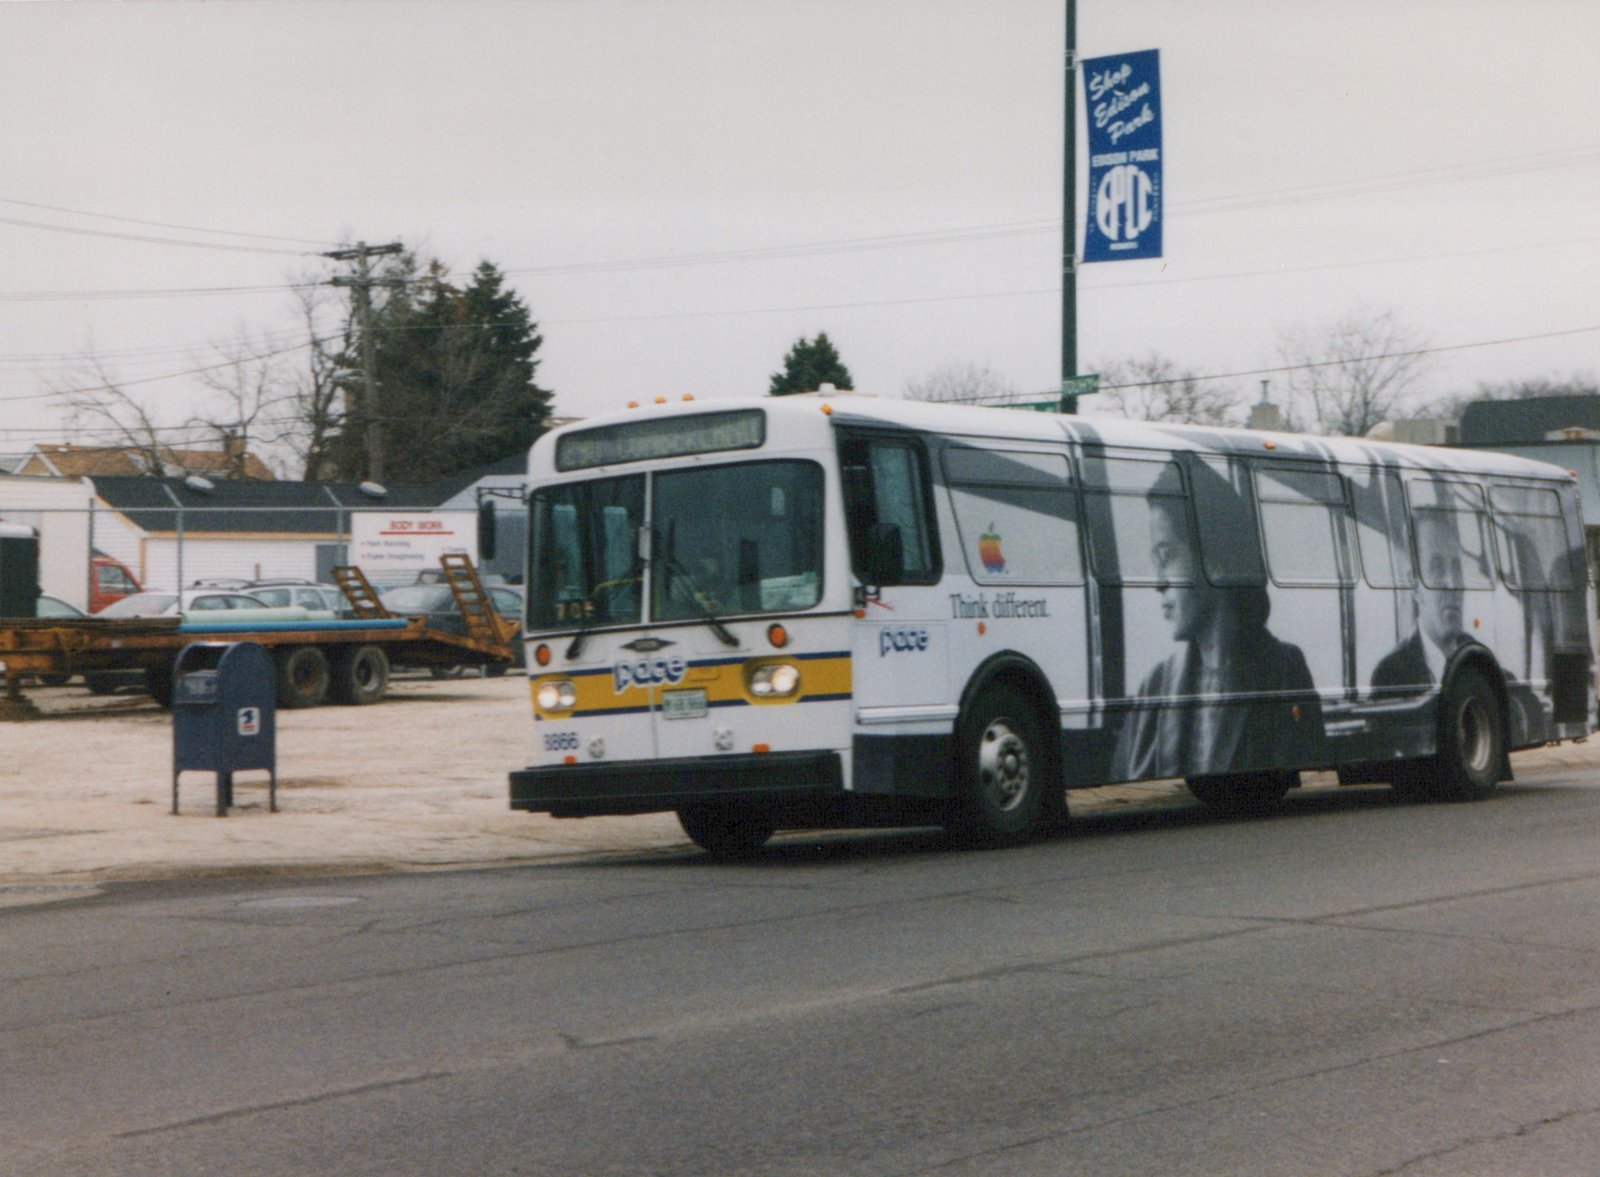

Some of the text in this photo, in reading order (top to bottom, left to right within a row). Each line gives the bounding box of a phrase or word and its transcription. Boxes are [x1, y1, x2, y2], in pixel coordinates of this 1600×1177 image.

[1089, 63, 1132, 100] Shop
[1094, 82, 1149, 127] Edison
[1107, 103, 1154, 145] Park
[1129, 148, 1158, 162] PARK
[390, 521, 442, 530] BODY WORK
[950, 591, 1051, 619] Think different.
[880, 627, 929, 657] pace
[615, 657, 684, 693] pace
